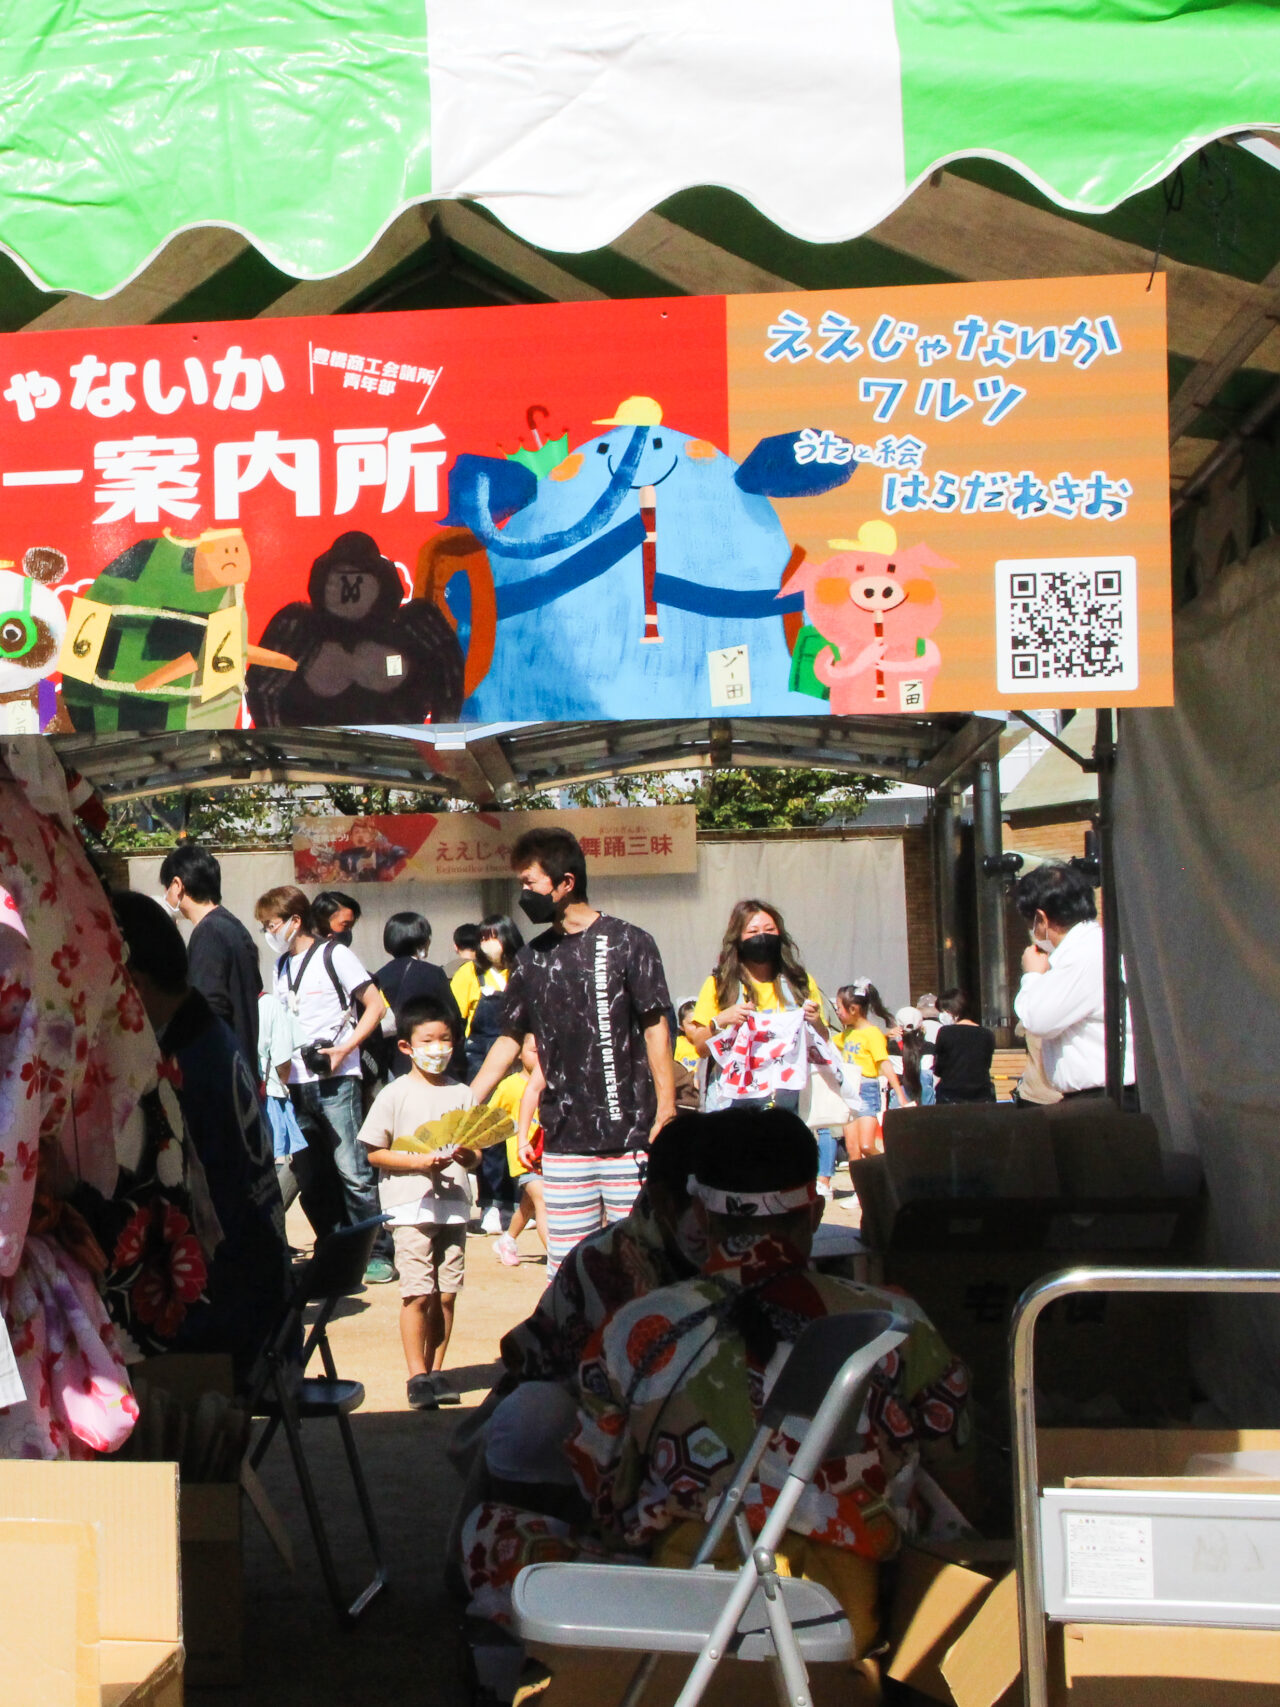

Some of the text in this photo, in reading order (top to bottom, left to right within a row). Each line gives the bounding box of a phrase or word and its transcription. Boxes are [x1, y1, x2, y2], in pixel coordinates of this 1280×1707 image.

[765, 310, 1122, 368] ええじゃないか
[342, 372, 397, 397] 青年部
[858, 375, 1027, 427] ワルツ
[793, 428, 927, 470] うたと絵
[72, 612, 97, 658] 6
[211, 630, 235, 674] 6
[596, 1000, 612, 1047] HOLIDAY
[606, 1085, 622, 1121] BEACH
